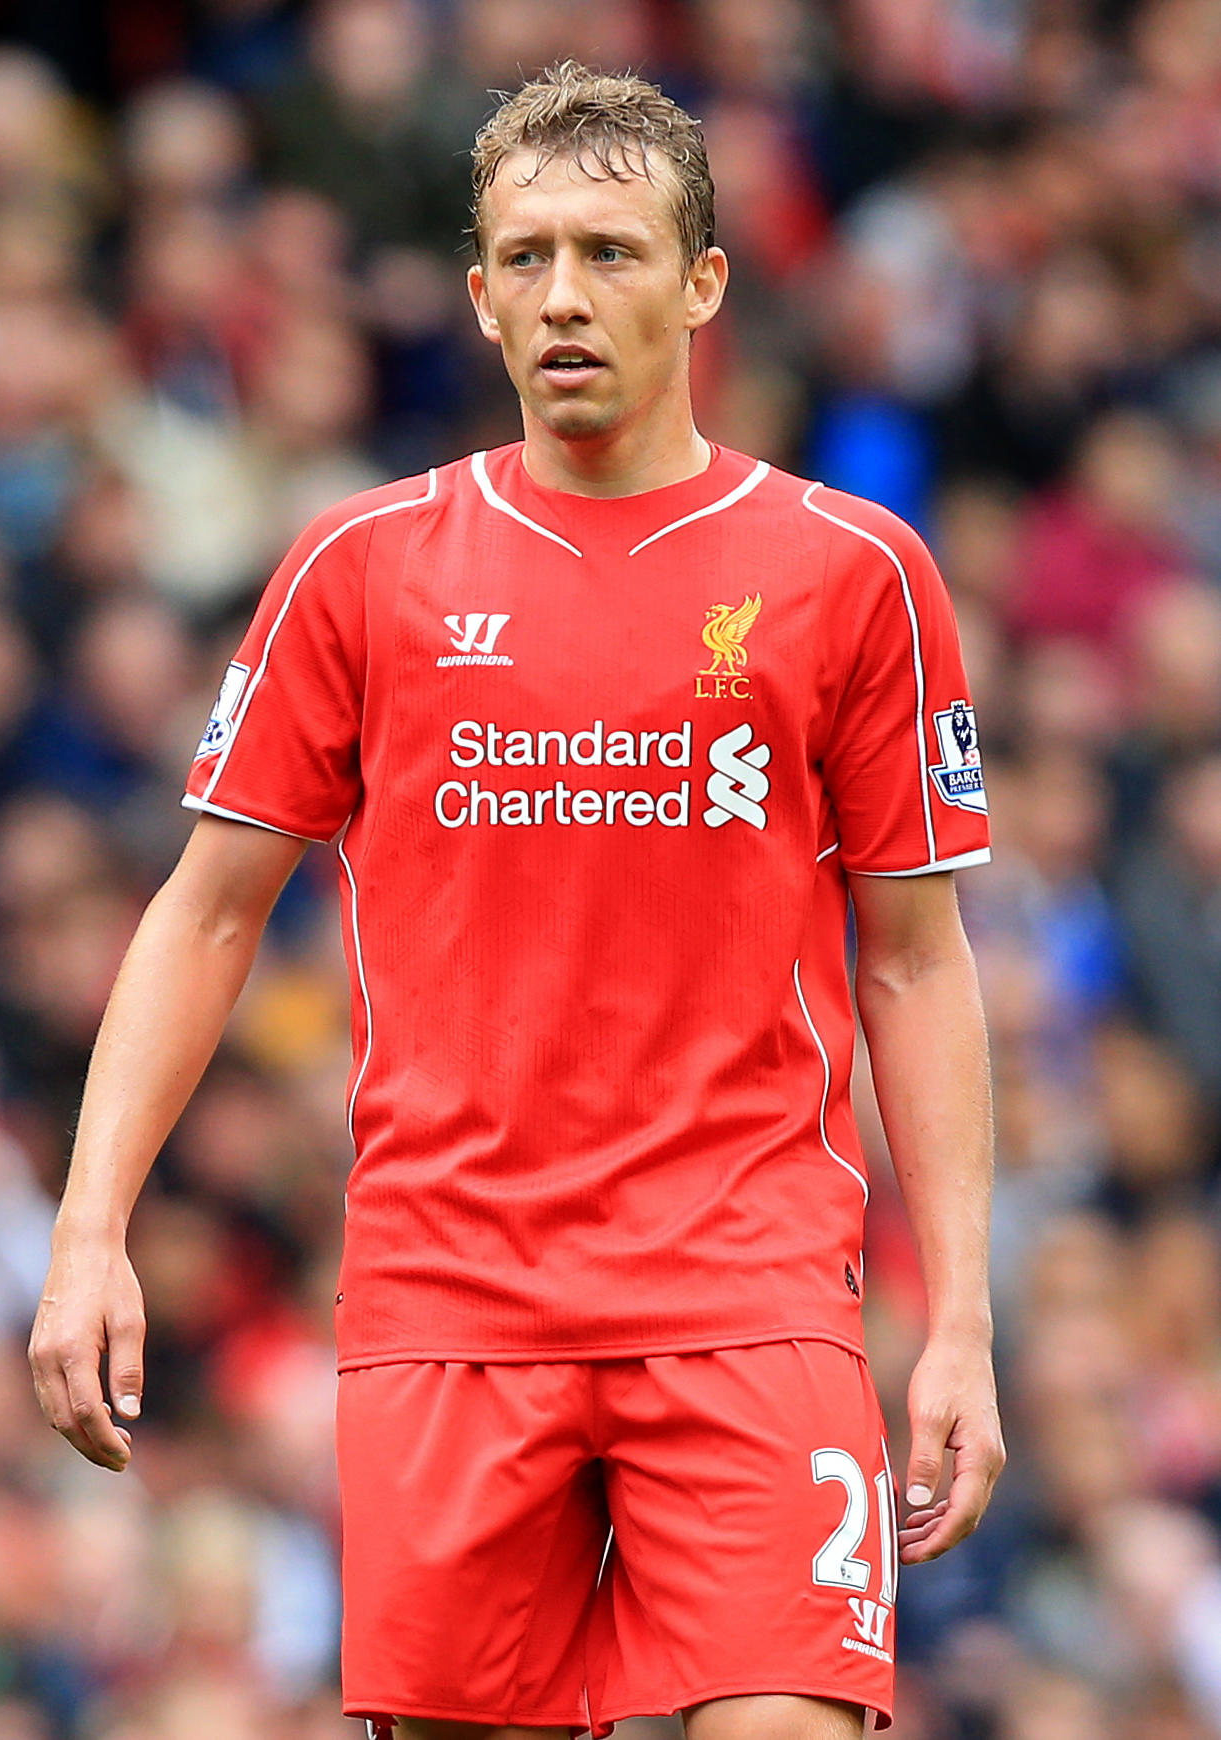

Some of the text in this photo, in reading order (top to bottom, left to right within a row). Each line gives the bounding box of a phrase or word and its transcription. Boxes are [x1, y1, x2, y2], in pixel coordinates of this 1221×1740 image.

[695, 677, 754, 699] L.F.C.
[450, 720, 692, 768] Standard
[435, 780, 691, 828] Chartered
[810, 1447, 894, 1608] 21
